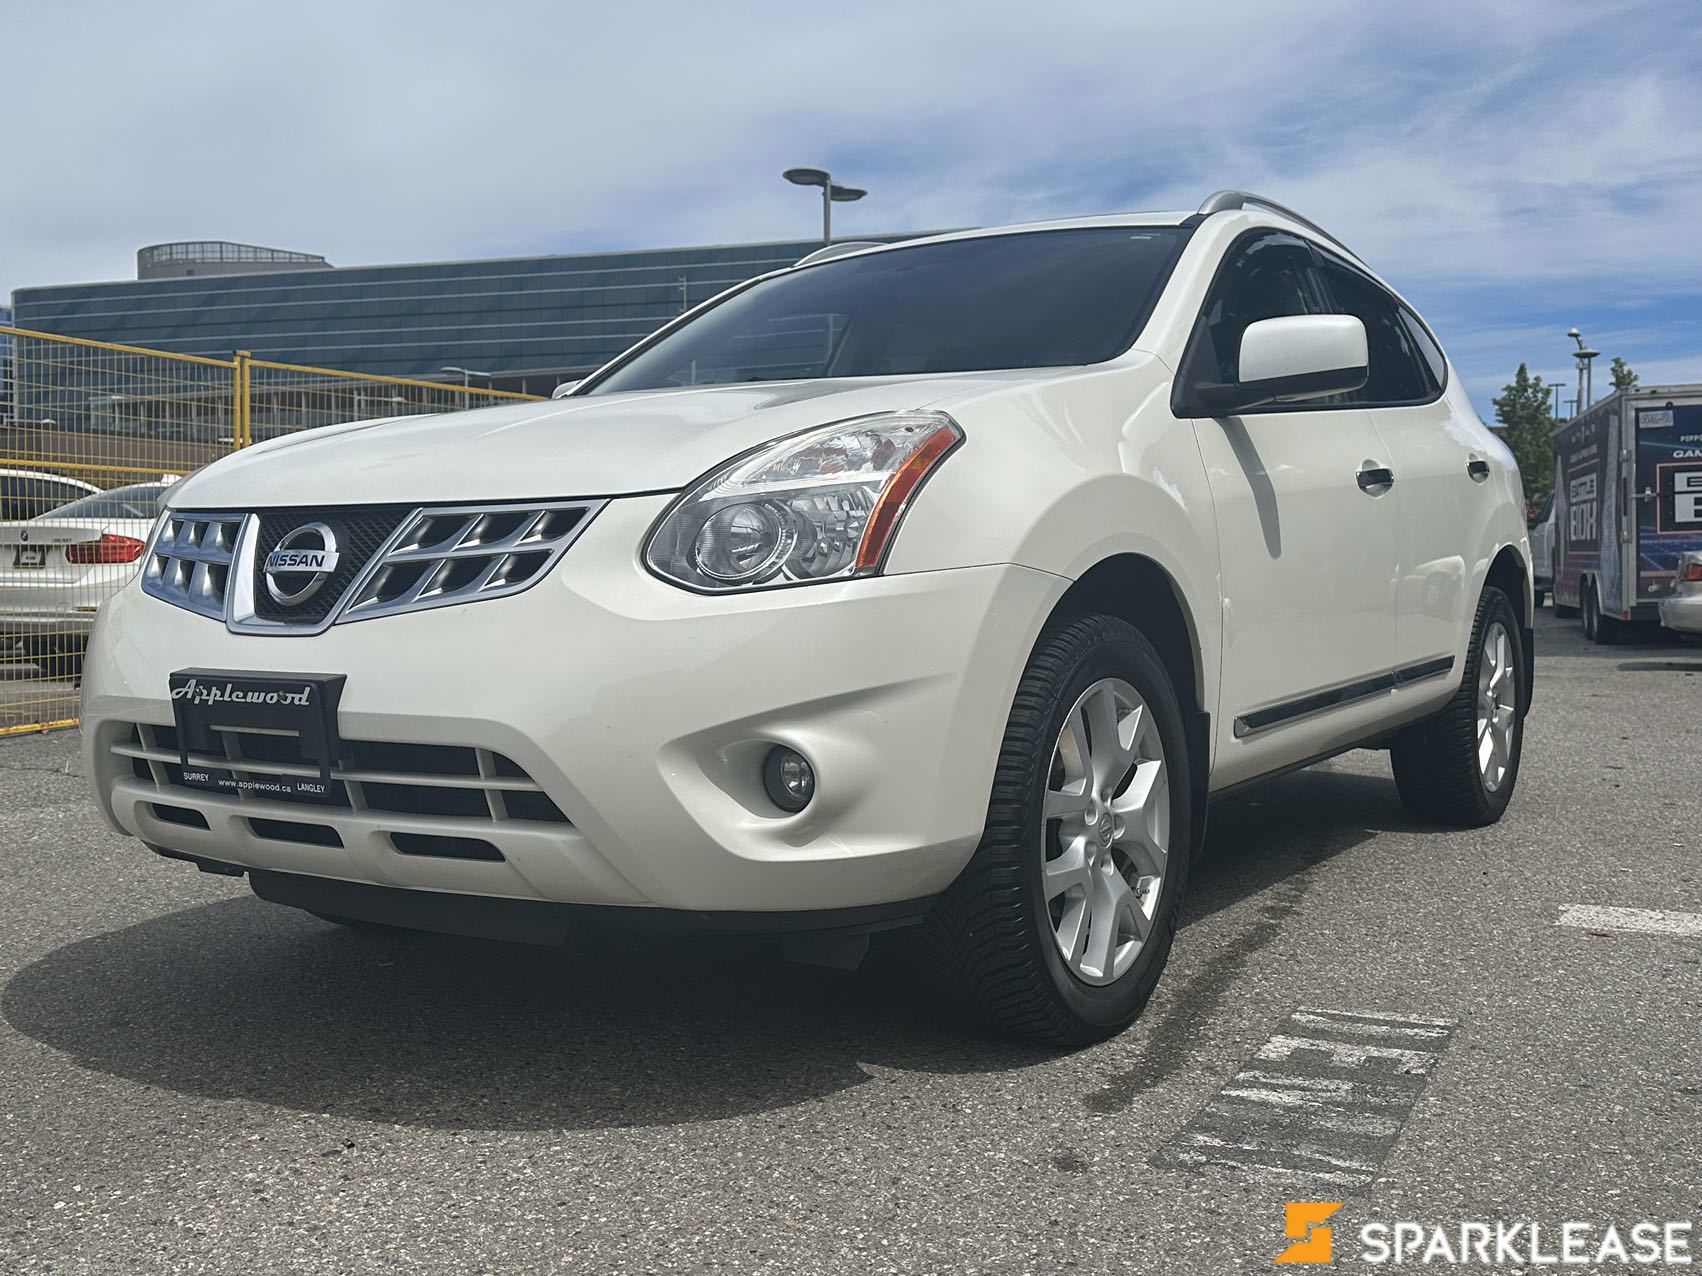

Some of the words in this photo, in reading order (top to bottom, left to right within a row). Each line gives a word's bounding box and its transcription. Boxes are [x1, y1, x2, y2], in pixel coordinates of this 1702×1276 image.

[268, 554, 325, 568] NISSAN
[171, 679, 312, 705] Applewood
[183, 771, 209, 782] SURREY
[217, 778, 292, 793] www.applewood.ca
[297, 782, 325, 793] LANGLEY
